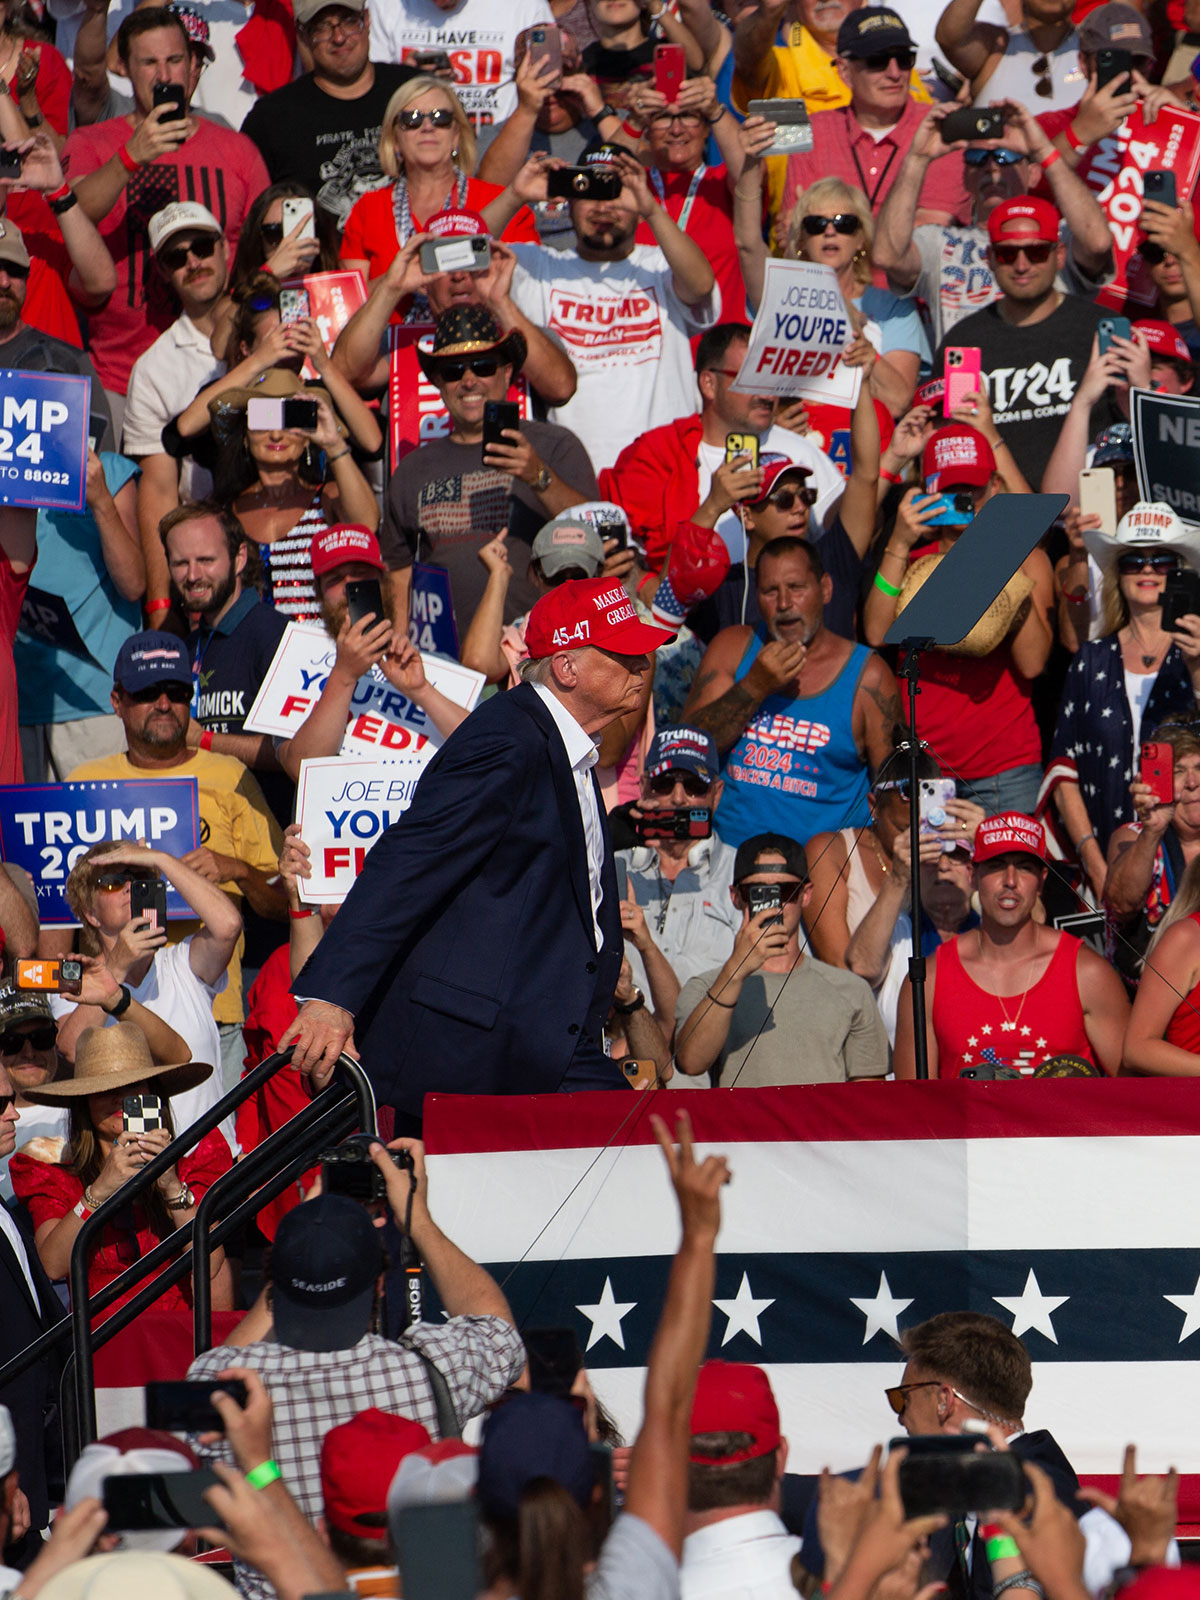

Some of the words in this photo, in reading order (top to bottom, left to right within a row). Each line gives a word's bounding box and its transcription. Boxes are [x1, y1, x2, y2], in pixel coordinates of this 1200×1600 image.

[437, 31, 477, 45] HAVE
[781, 286, 806, 309] JOE
[558, 297, 650, 325] TRUMP
[584, 328, 625, 345] RALLY
[774, 312, 847, 346] YOU'RE
[756, 346, 843, 380] FIRED!
[936, 436, 975, 446] JESUS
[23, 468, 70, 486] 88022
[1128, 513, 1172, 528] TRUMP
[339, 529, 371, 543] AMERICA
[592, 587, 620, 611] MAKE
[552, 620, 590, 647] 45-47
[658, 729, 709, 746] Trump
[744, 742, 793, 773] 2024
[331, 780, 384, 803] JOE
[771, 772, 780, 788] A
[782, 775, 817, 797] BITCH
[15, 807, 178, 845] TRUMP
[980, 819, 1006, 832] MAKE
[1006, 816, 1042, 838] AMERICA
[984, 831, 1014, 845] GREAT
[1015, 831, 1039, 848] AGAIN
[291, 1277, 348, 1293] SEASIDE
